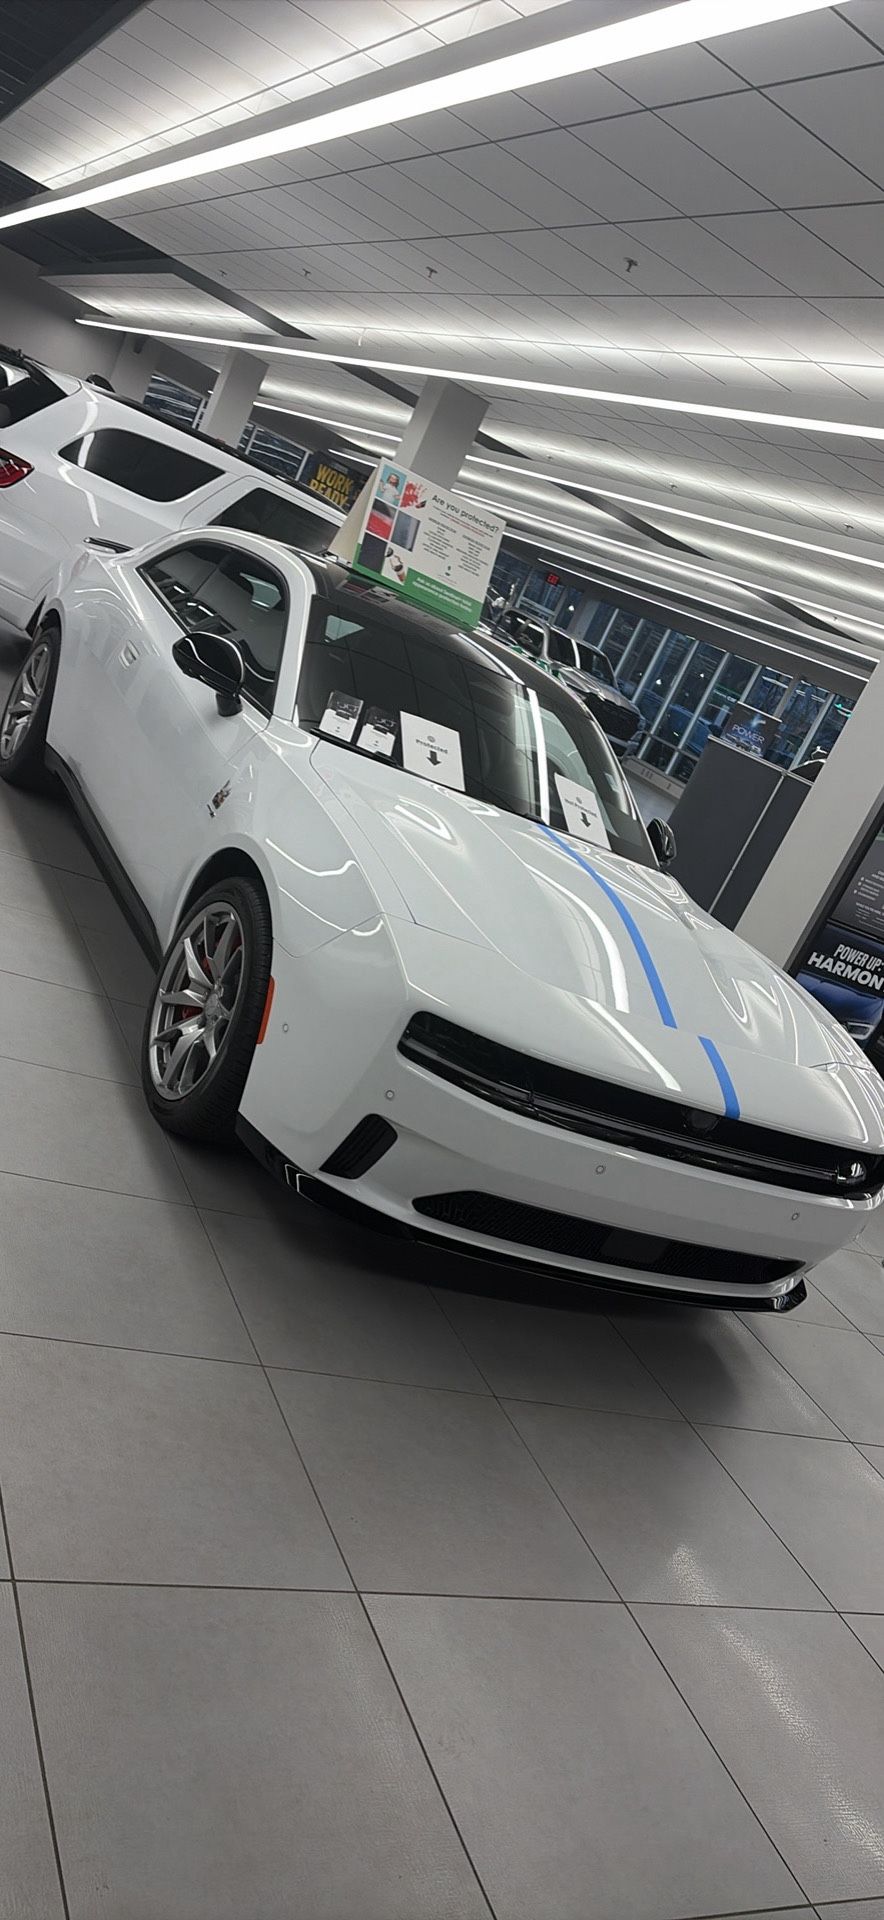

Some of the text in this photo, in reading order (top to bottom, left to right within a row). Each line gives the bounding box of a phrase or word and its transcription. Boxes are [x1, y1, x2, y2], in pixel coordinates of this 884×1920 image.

[317, 464, 354, 495] WORK
[432, 495, 445, 506] Are
[446, 502, 460, 514] you
[460, 510, 500, 534] protected?
[415, 738, 448, 755] Protected
[732, 724, 765, 744] POWER
[833, 943, 870, 968] POWER
[807, 951, 884, 993] HARMON
